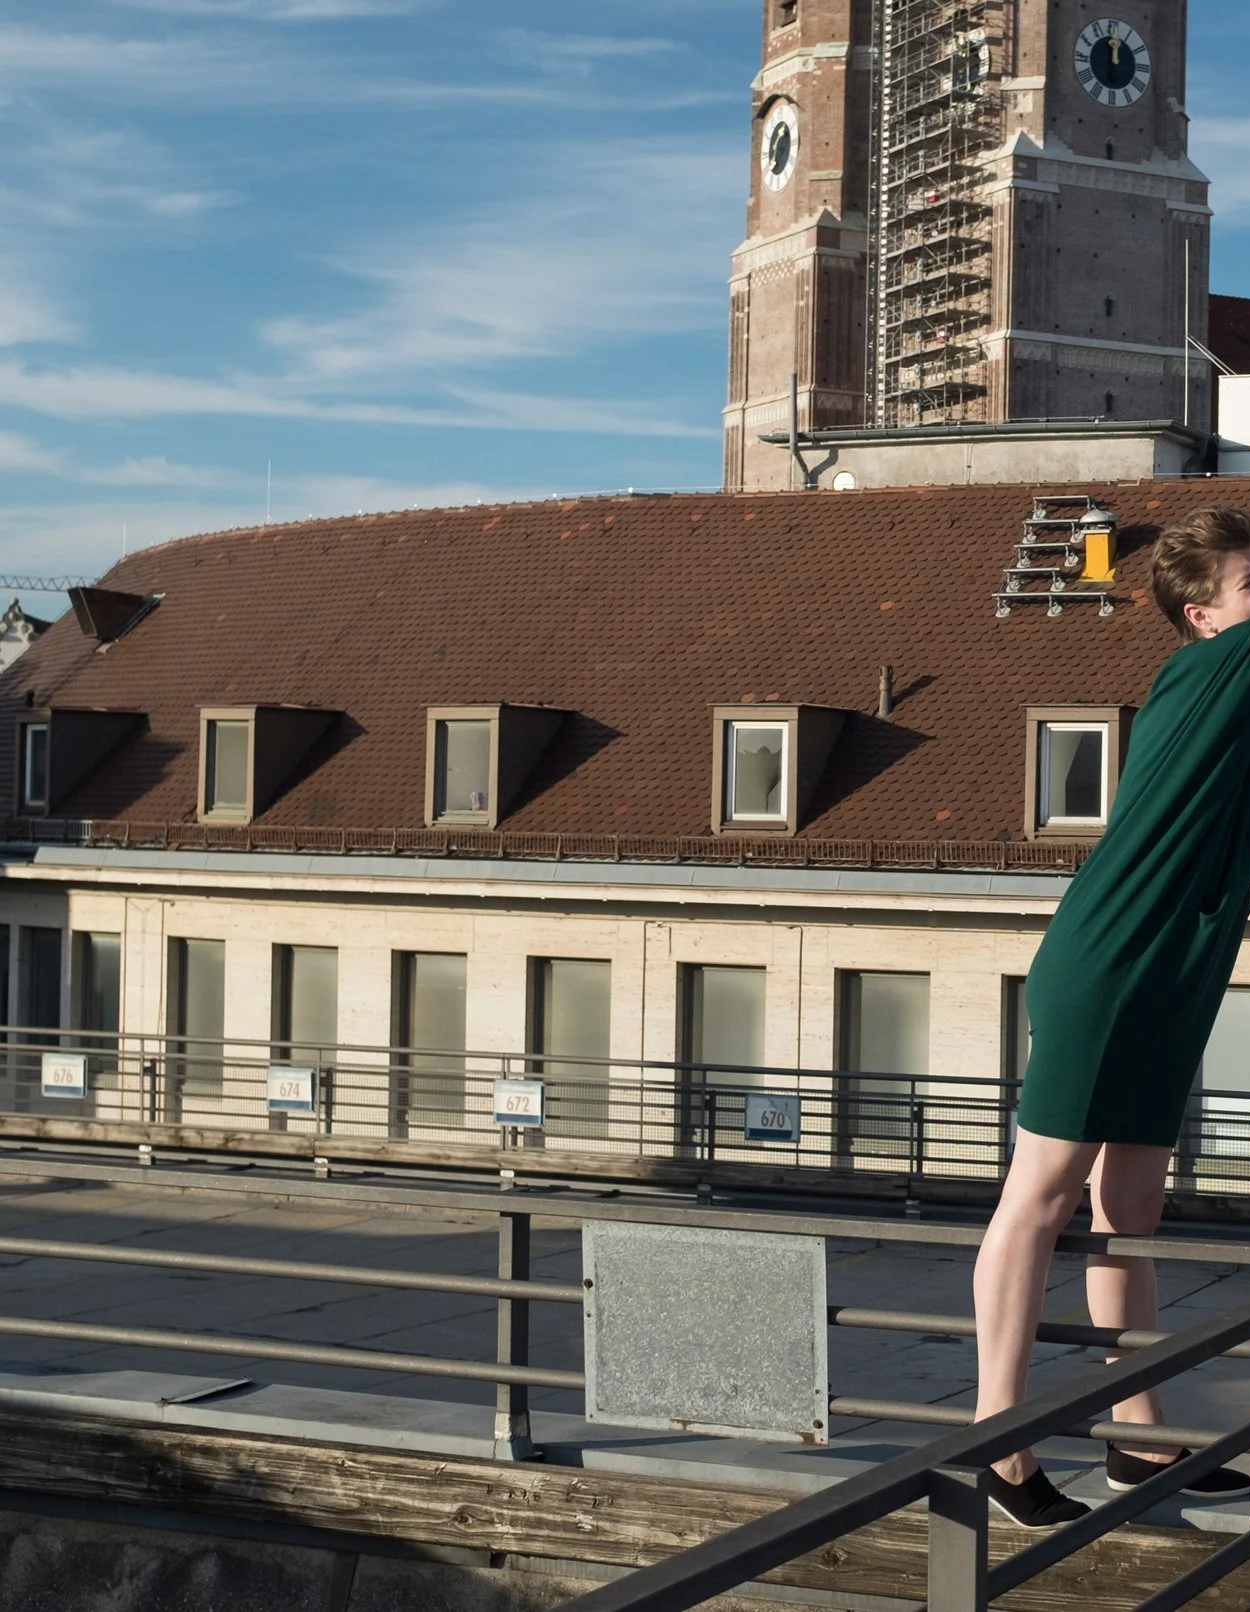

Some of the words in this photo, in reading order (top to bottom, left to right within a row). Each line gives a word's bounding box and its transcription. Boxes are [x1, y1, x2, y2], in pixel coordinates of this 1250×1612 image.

[53, 1068, 73, 1084] 676
[280, 1081, 300, 1098] 674
[506, 1095, 530, 1113] 672
[761, 1110, 785, 1128] 670
